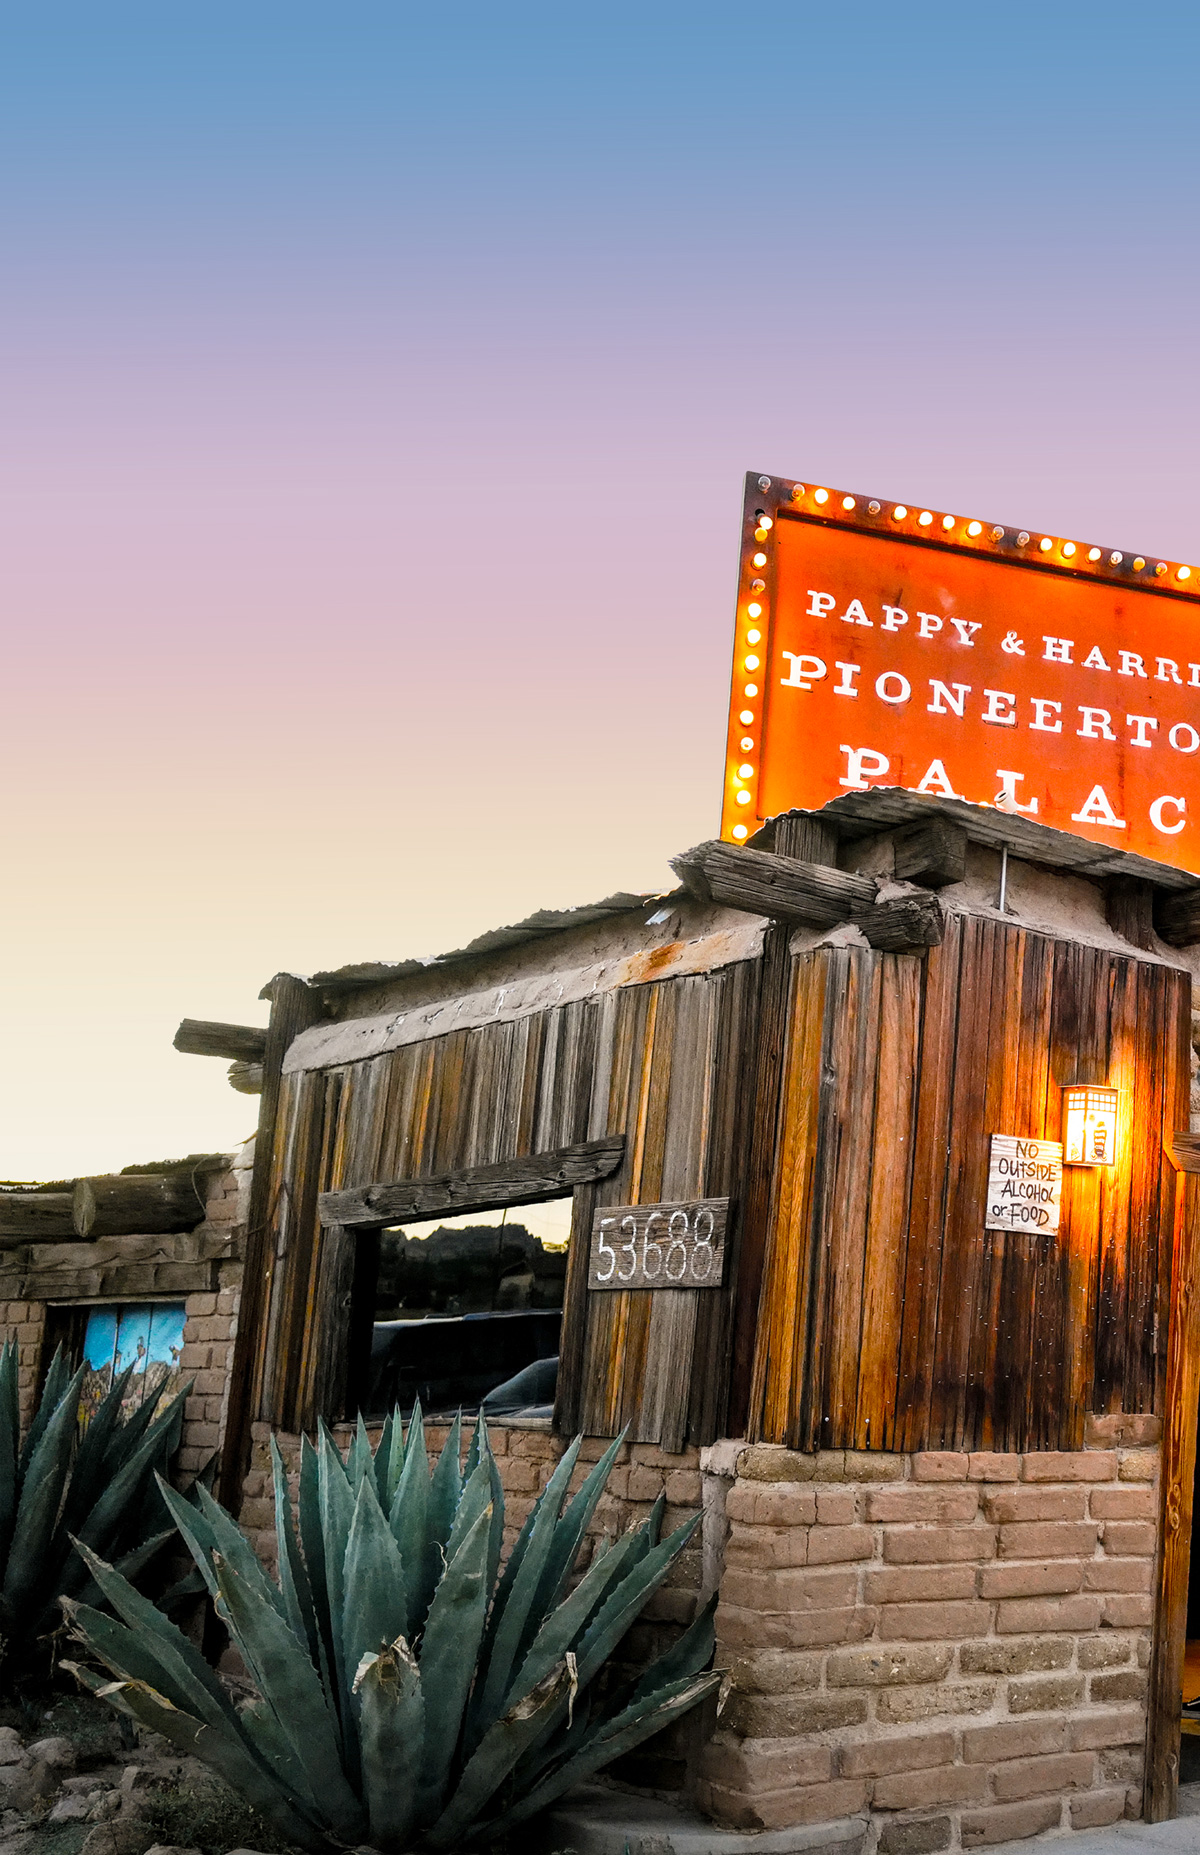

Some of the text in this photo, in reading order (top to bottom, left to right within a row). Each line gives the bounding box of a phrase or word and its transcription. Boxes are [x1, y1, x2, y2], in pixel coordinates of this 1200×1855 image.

[806, 590, 982, 647] PAPPY
[1000, 630, 1026, 657] &
[1016, 1140, 1039, 1159] NO
[998, 1158, 1058, 1182] OUTSIDE
[1001, 1179, 1055, 1204] ALCOHOL
[1009, 1203, 1050, 1227] FOOD
[597, 1210, 714, 1281] 53688
